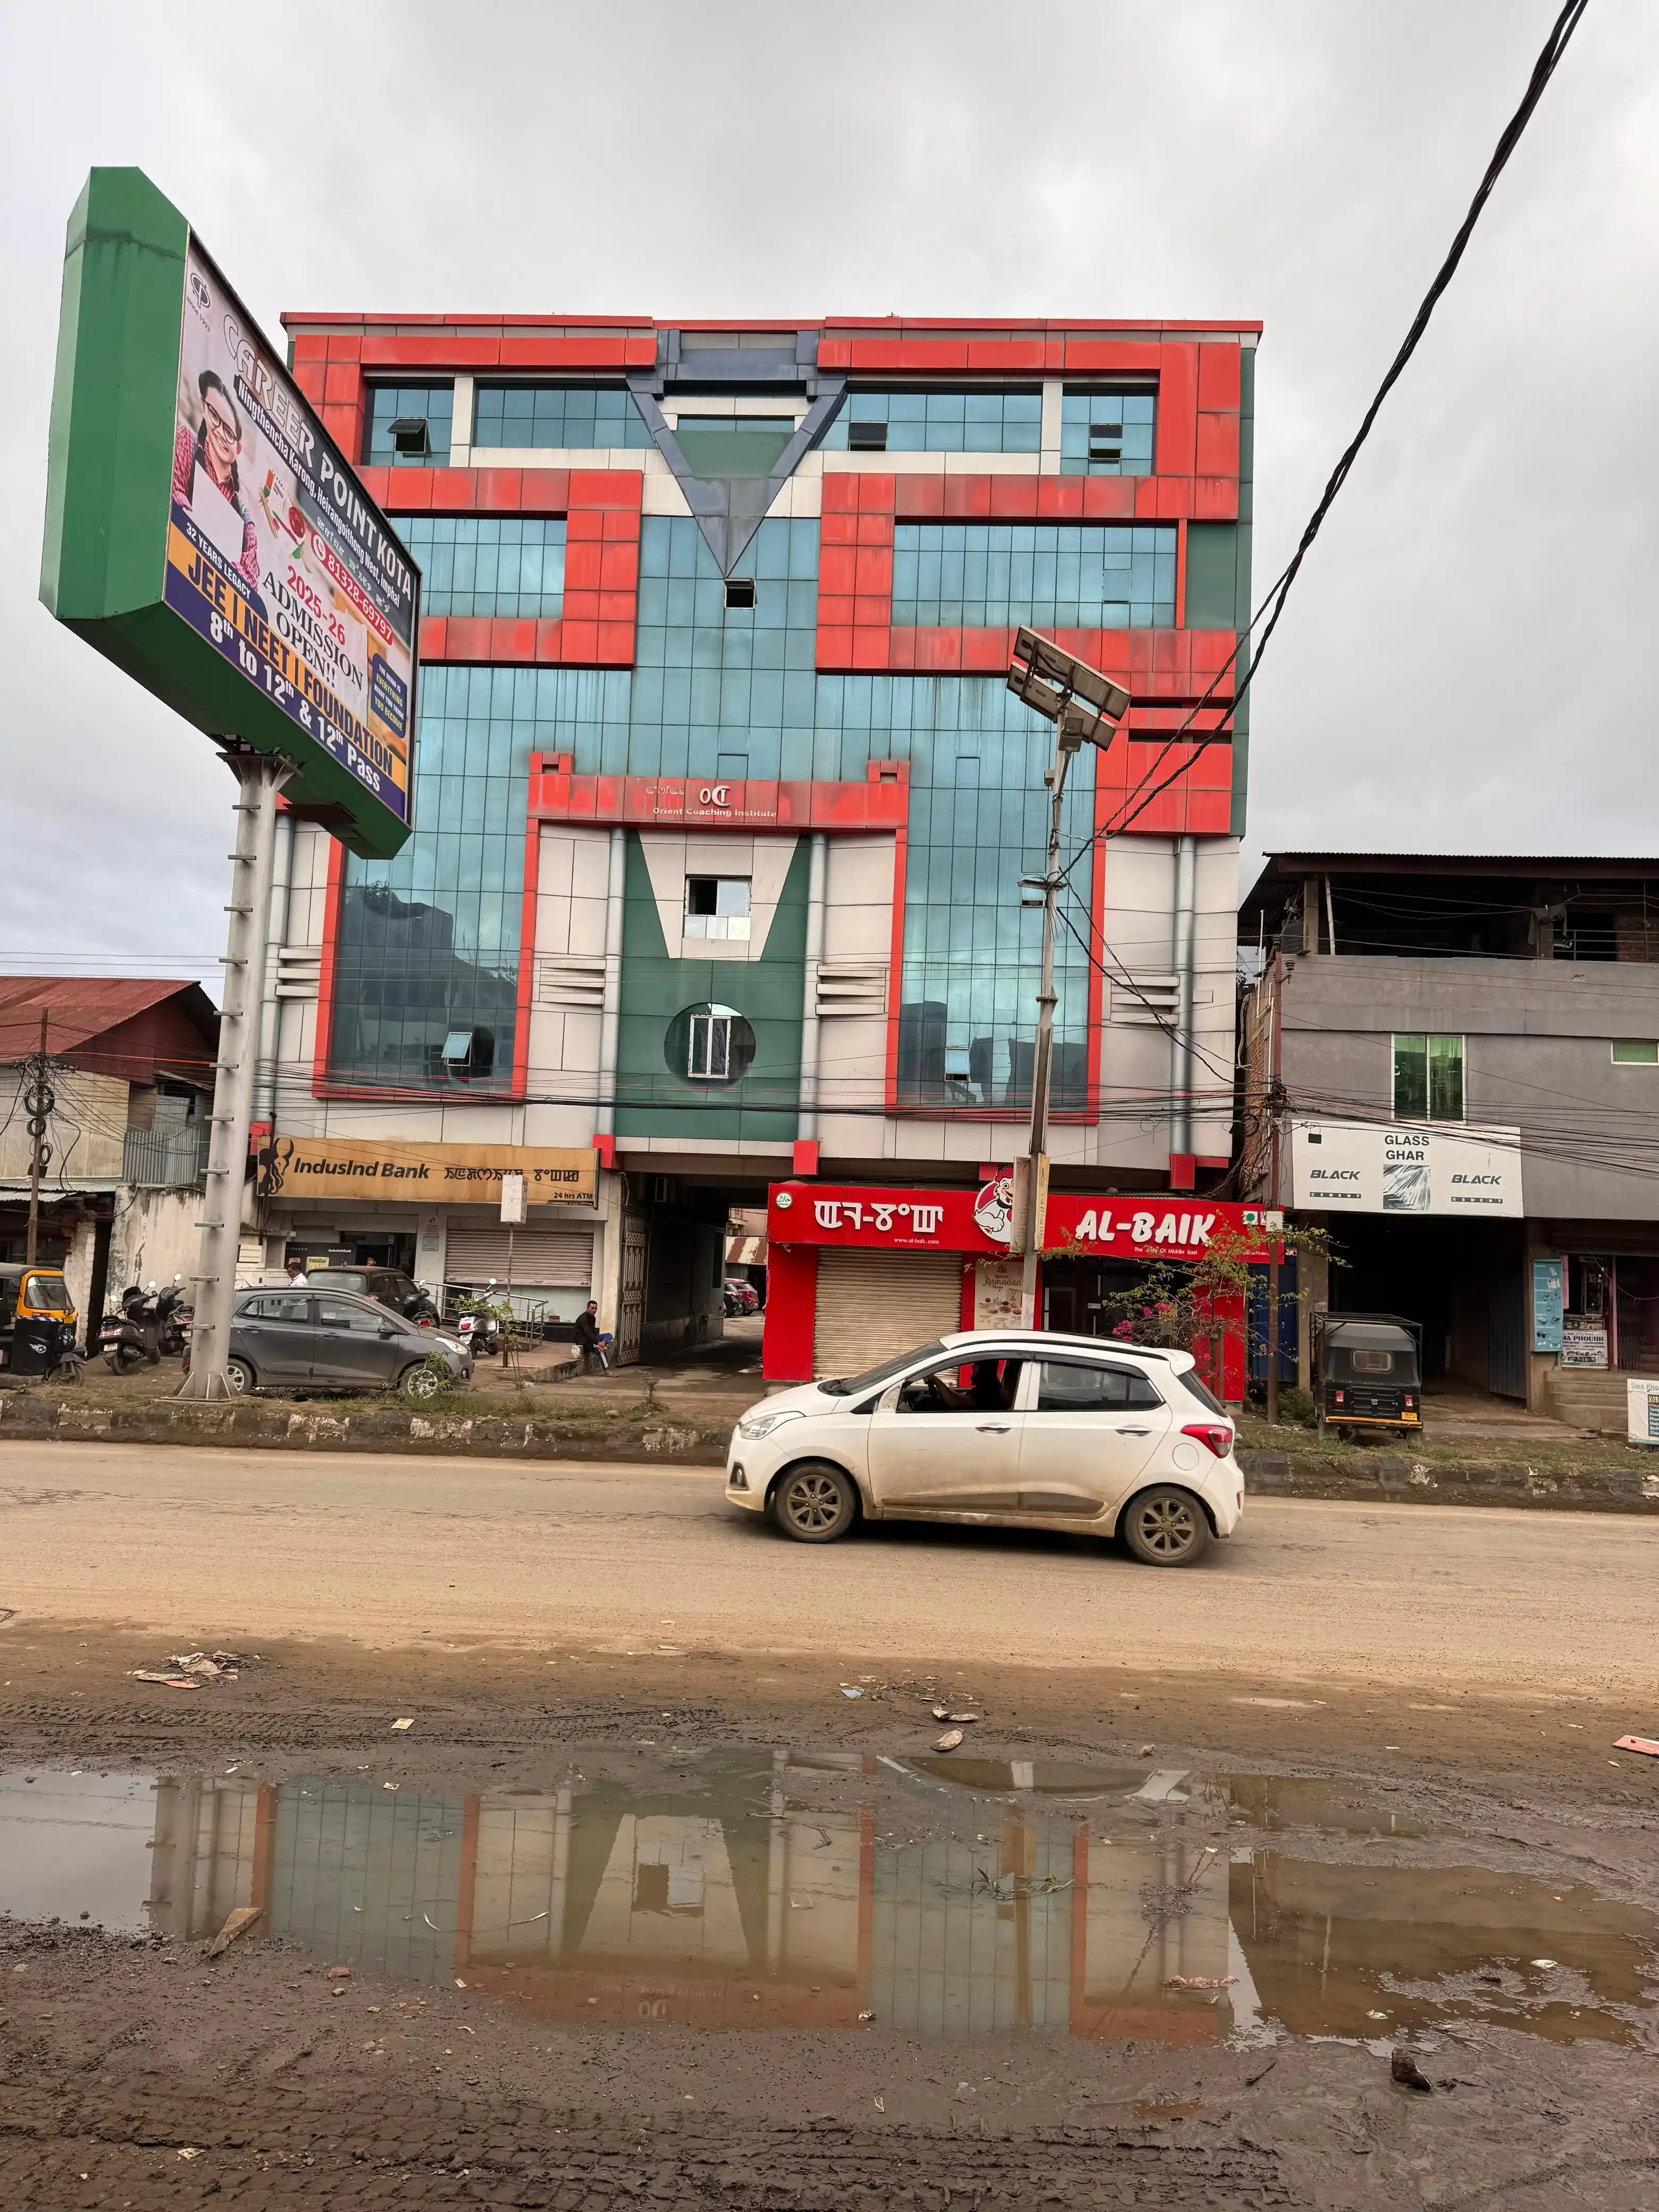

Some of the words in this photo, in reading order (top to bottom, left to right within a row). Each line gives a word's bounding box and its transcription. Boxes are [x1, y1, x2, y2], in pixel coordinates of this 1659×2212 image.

[223, 314, 315, 468] CAREER
[320, 451, 377, 549] POINT
[376, 532, 411, 601] KOTA
[238, 379, 289, 461] Ningthencha
[288, 451, 316, 499] Karong,
[317, 487, 365, 565] Heirangoithong
[365, 552, 380, 585] West,
[380, 573, 400, 608] Imphal
[186, 522, 197, 542] 32
[198, 534, 223, 569] YEARS
[223, 563, 252, 600] LEGACY
[327, 554, 392, 641] 81328-69797
[263, 571, 363, 691] ADMISSION
[287, 565, 345, 646] 2025-26
[188, 552, 227, 615] JEE
[244, 604, 290, 675] NEET
[304, 667, 392, 777] FOUNDATION
[276, 611, 336, 688] OPEN!!
[210, 611, 234, 644] 8th
[239, 639, 257, 677] to
[264, 665, 294, 705] 12th
[299, 699, 312, 729] &
[317, 716, 343, 752] 12th
[347, 742, 380, 792] Pass
[686, 808, 732, 817] Coaching
[734, 809, 777, 817] Institute
[294, 1158, 379, 1177] IndusInd
[381, 1163, 431, 1179] Bank
[1310, 1169, 1361, 1180] BLACK
[1384, 1135, 1430, 1146] GLASS
[1385, 1150, 1425, 1161] GHAR
[1451, 1174, 1502, 1185] BLACK
[1075, 1210, 1216, 1247] AL-BAIK
[982, 1276, 1021, 1287] Ramadan
